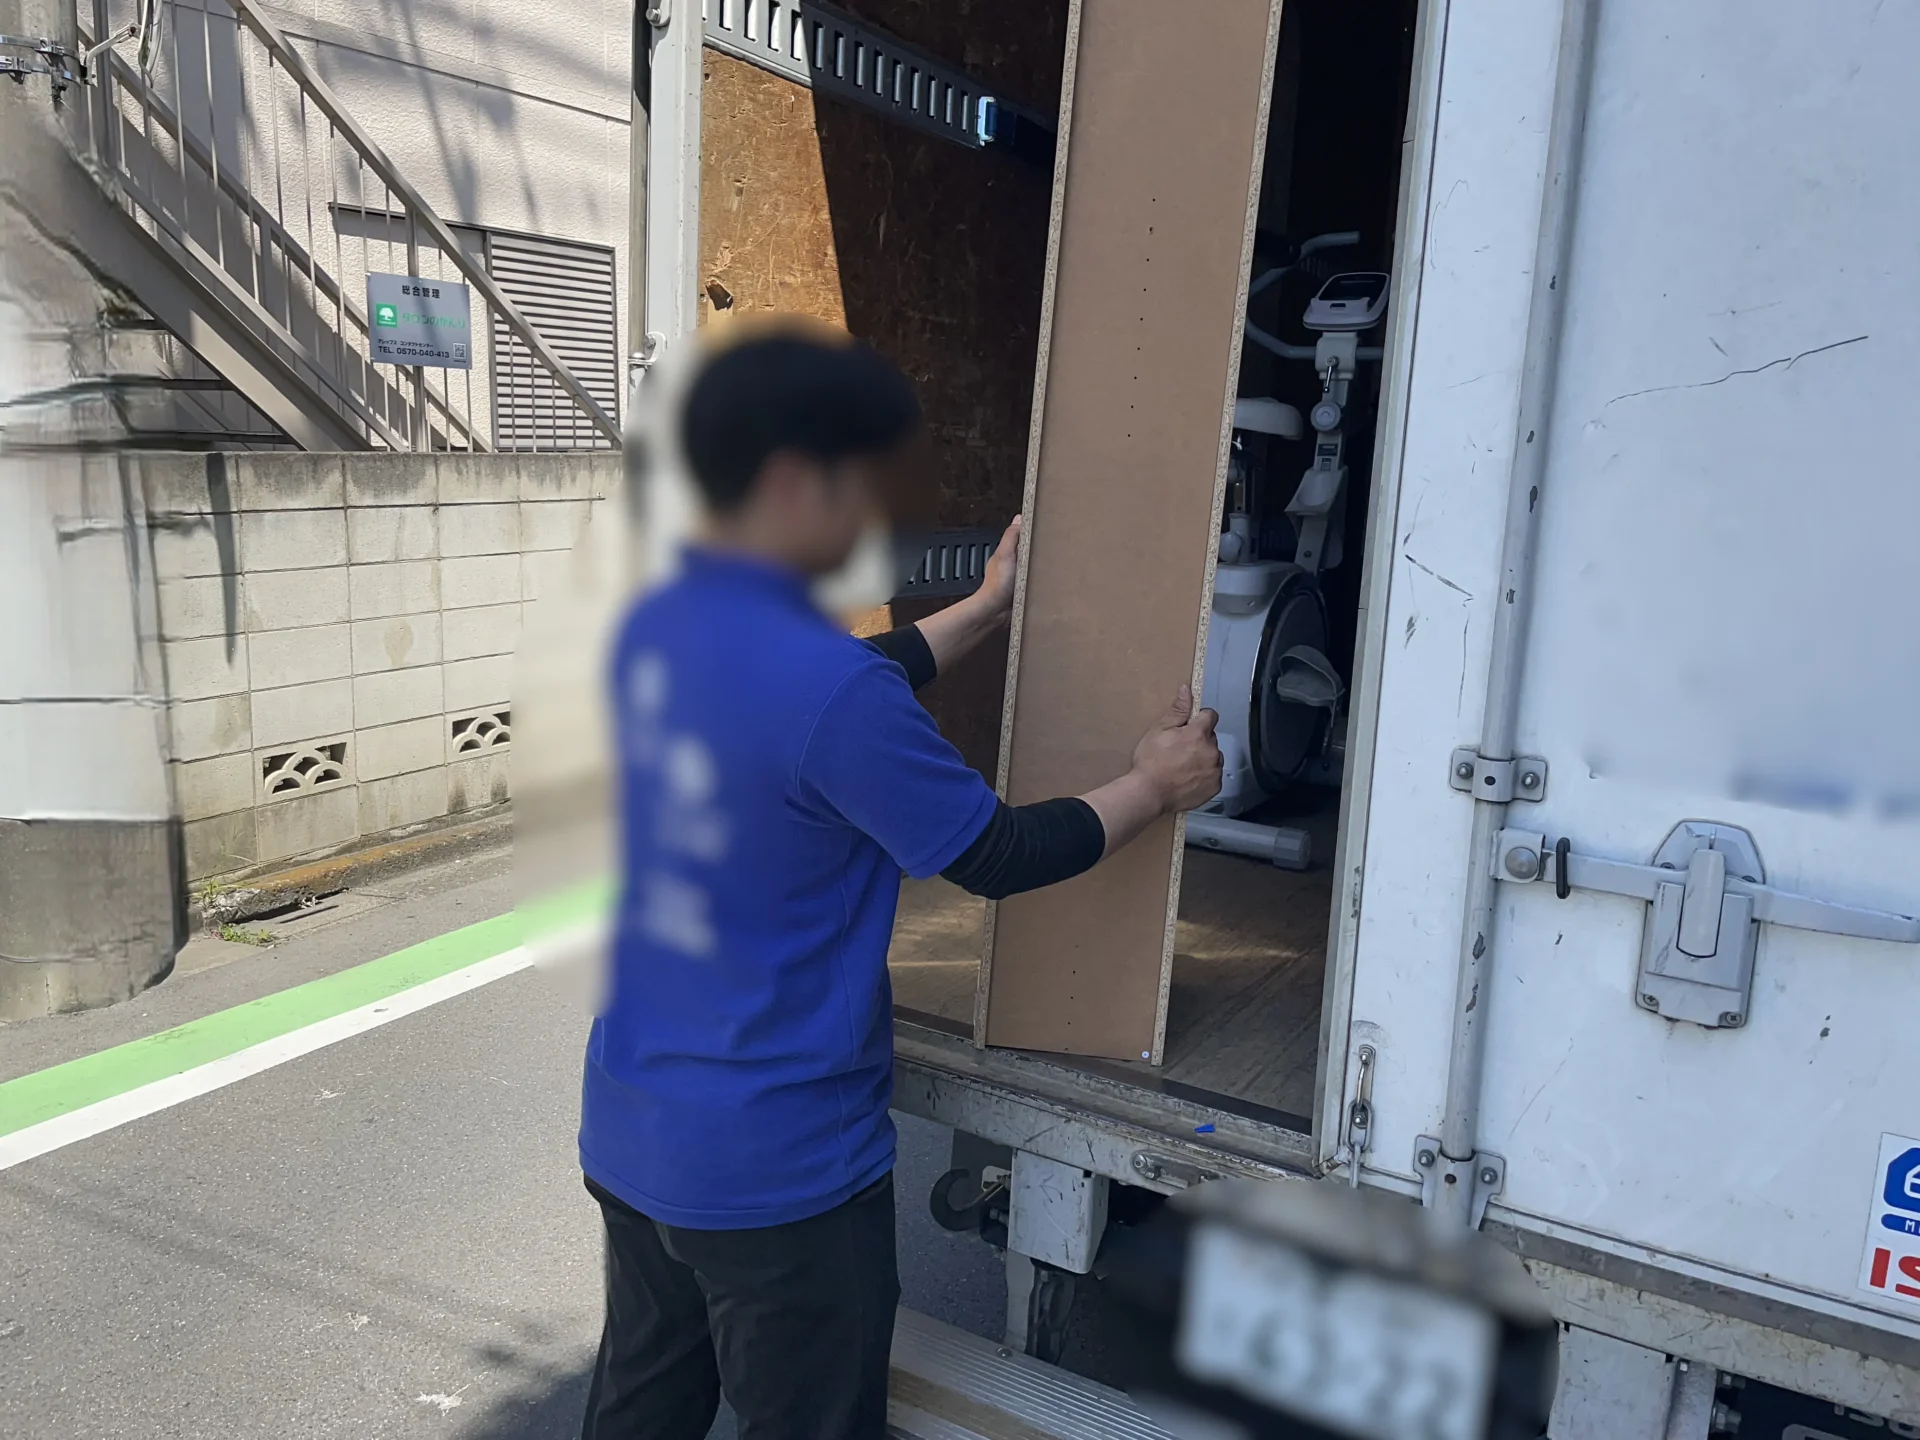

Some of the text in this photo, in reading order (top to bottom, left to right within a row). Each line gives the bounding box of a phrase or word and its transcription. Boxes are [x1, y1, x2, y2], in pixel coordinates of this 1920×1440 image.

[402, 285, 440, 298] 総合管理
[378, 346, 450, 358] TEL. 0570-040-413
